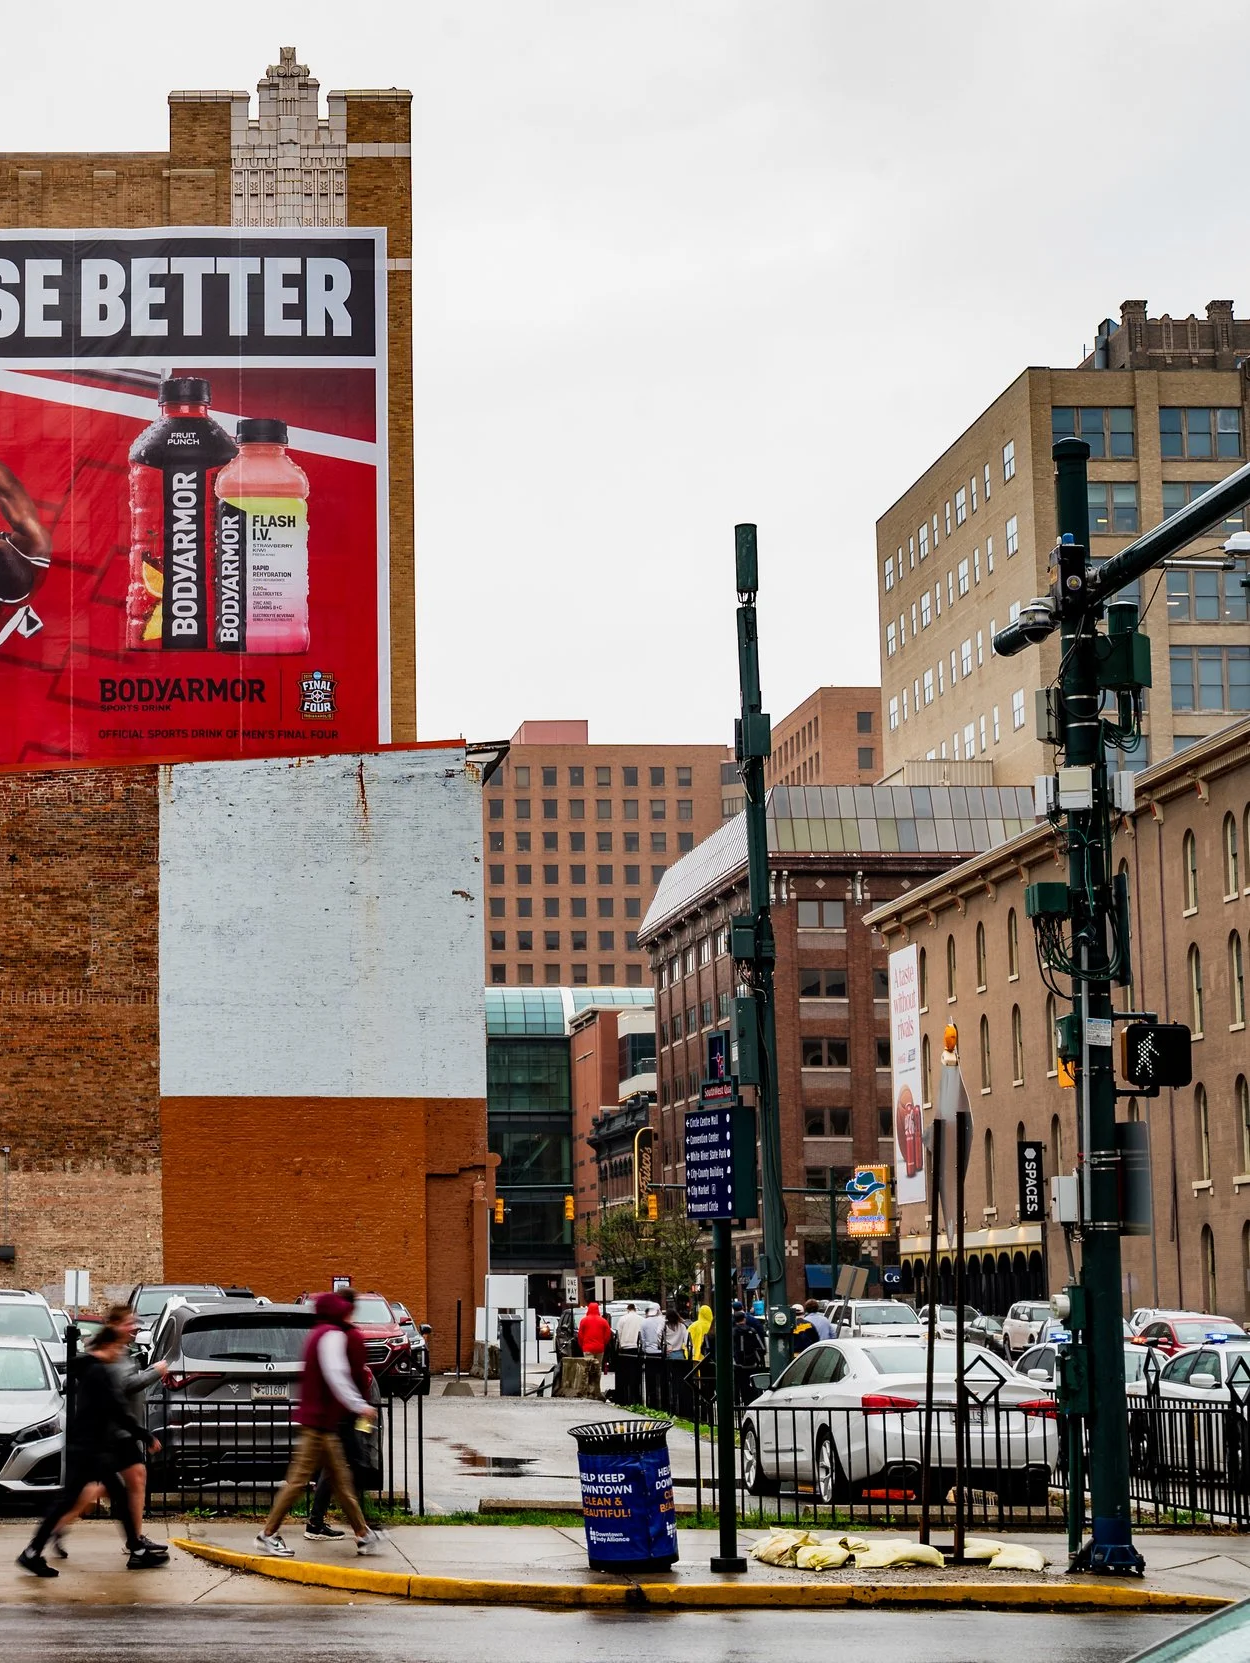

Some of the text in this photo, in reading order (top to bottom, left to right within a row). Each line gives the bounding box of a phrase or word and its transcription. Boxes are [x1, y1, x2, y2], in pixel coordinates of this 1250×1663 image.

[80, 257, 352, 337] BETTER
[252, 514, 296, 528] FLASH
[252, 528, 272, 541] I.V.
[171, 471, 199, 637] BODYARMOR
[220, 515, 240, 643] BODYARMOR
[99, 678, 266, 703] BODYARMOR
[302, 681, 332, 692] FINAL
[100, 704, 172, 712] SPORTS DRINK
[303, 702, 332, 712] FOUR
[98, 729, 339, 740] OFFICIAL SPORTS DRINK OF MEN'S FINAL FOUR
[899, 964, 914, 987] taste
[894, 989, 916, 1014] without
[897, 1015, 914, 1041] rivals
[639, 1146, 652, 1192] Frisco's
[1025, 1161, 1038, 1215] SPACES.
[567, 1279, 577, 1287] ONE
[597, 1473, 626, 1483] KEEP
[584, 1495, 623, 1506] CLEAN &
